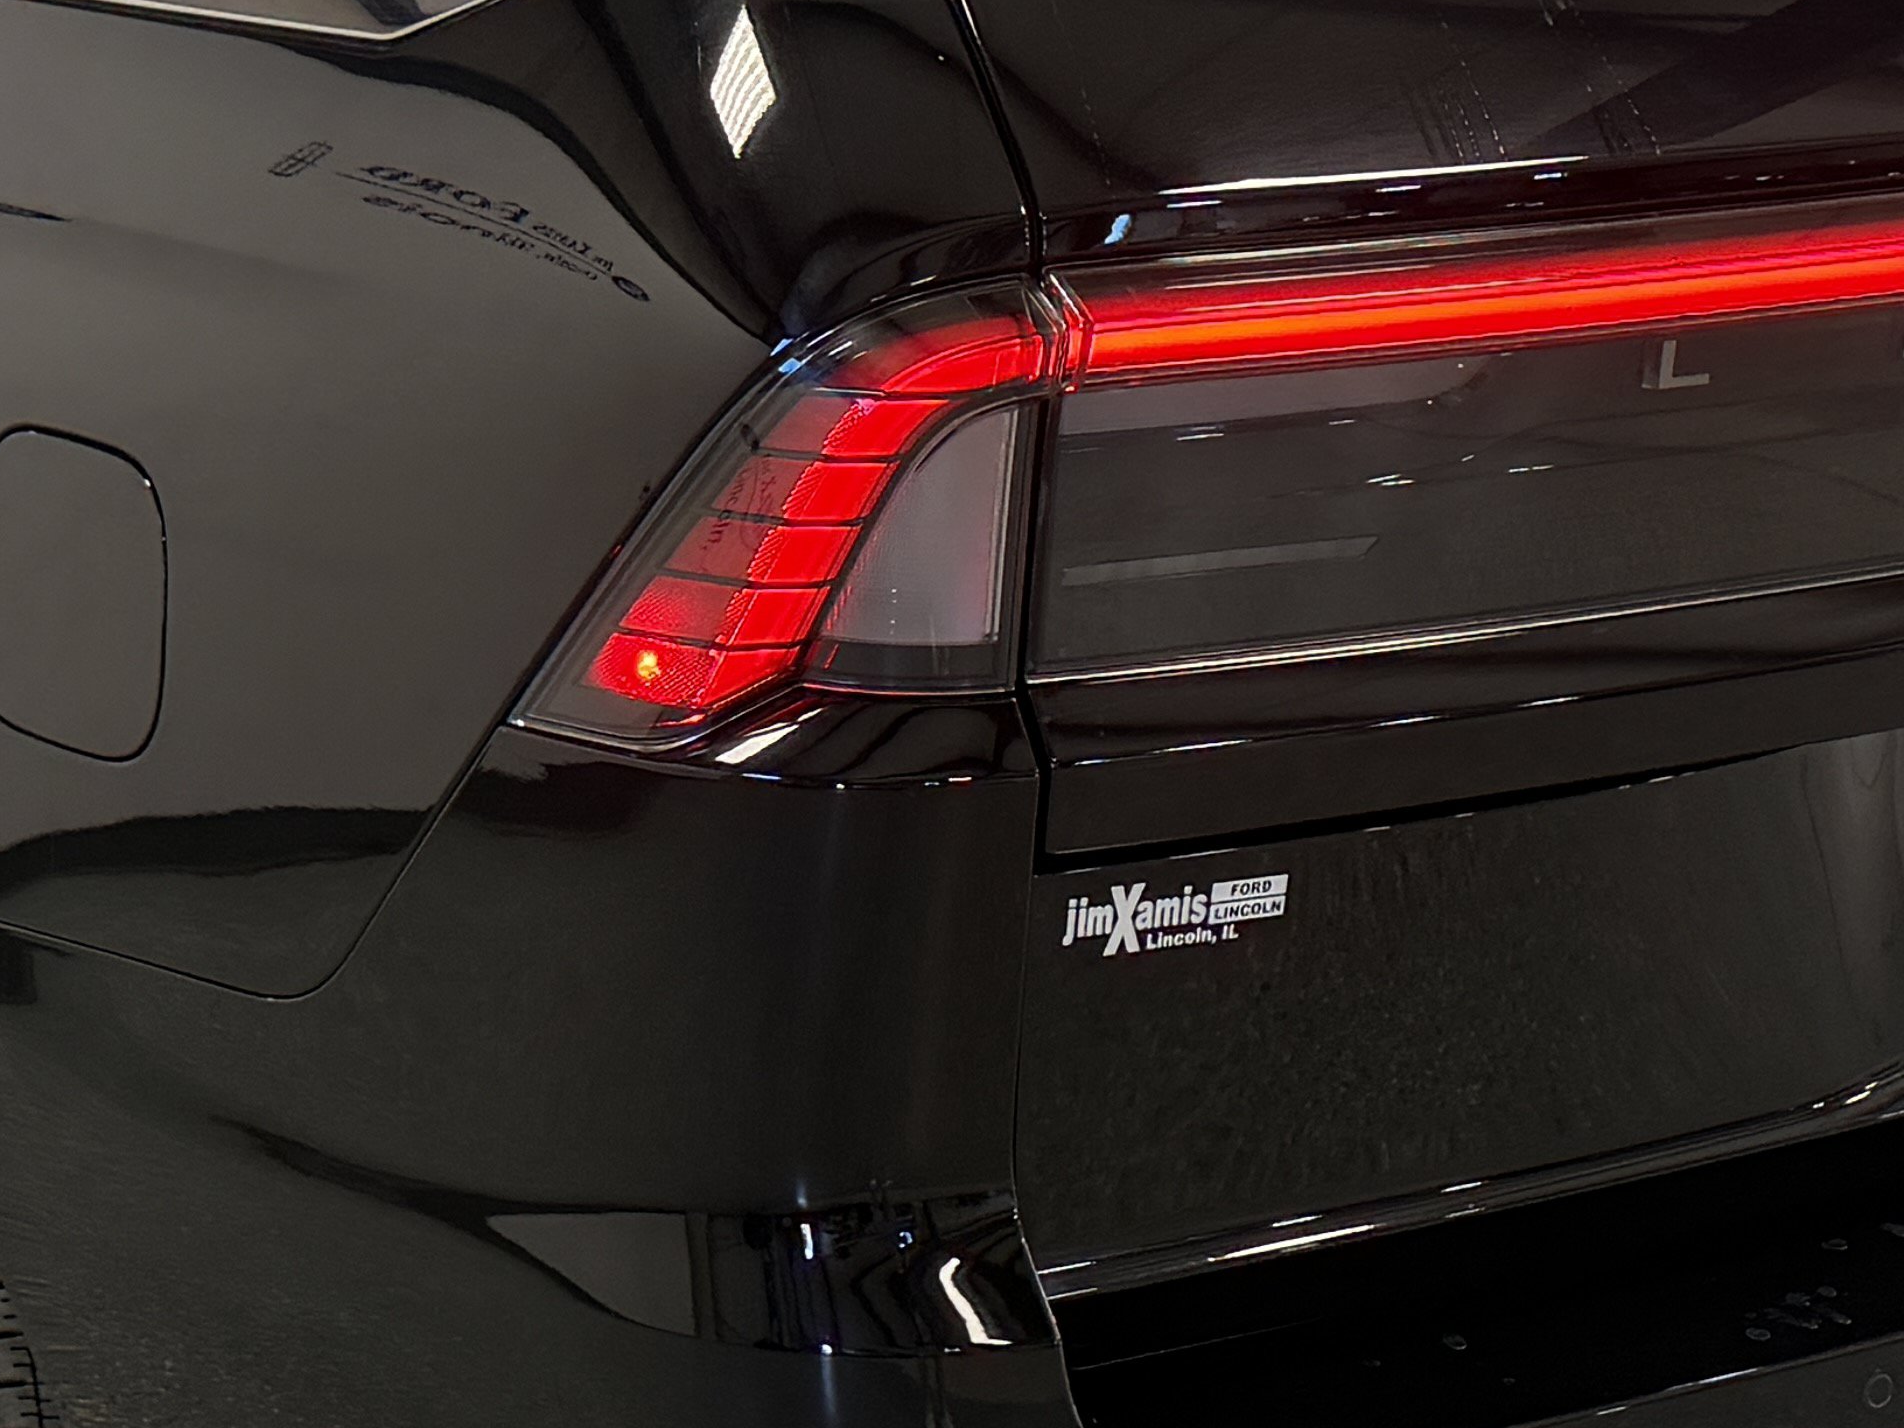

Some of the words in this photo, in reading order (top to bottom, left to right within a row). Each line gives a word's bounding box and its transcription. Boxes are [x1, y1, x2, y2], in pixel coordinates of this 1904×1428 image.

[1231, 879, 1272, 896] FORD
[1214, 900, 1282, 920] LINCOLN
[1146, 927, 1217, 950] Lincoln,
[1222, 924, 1239, 940] IL
